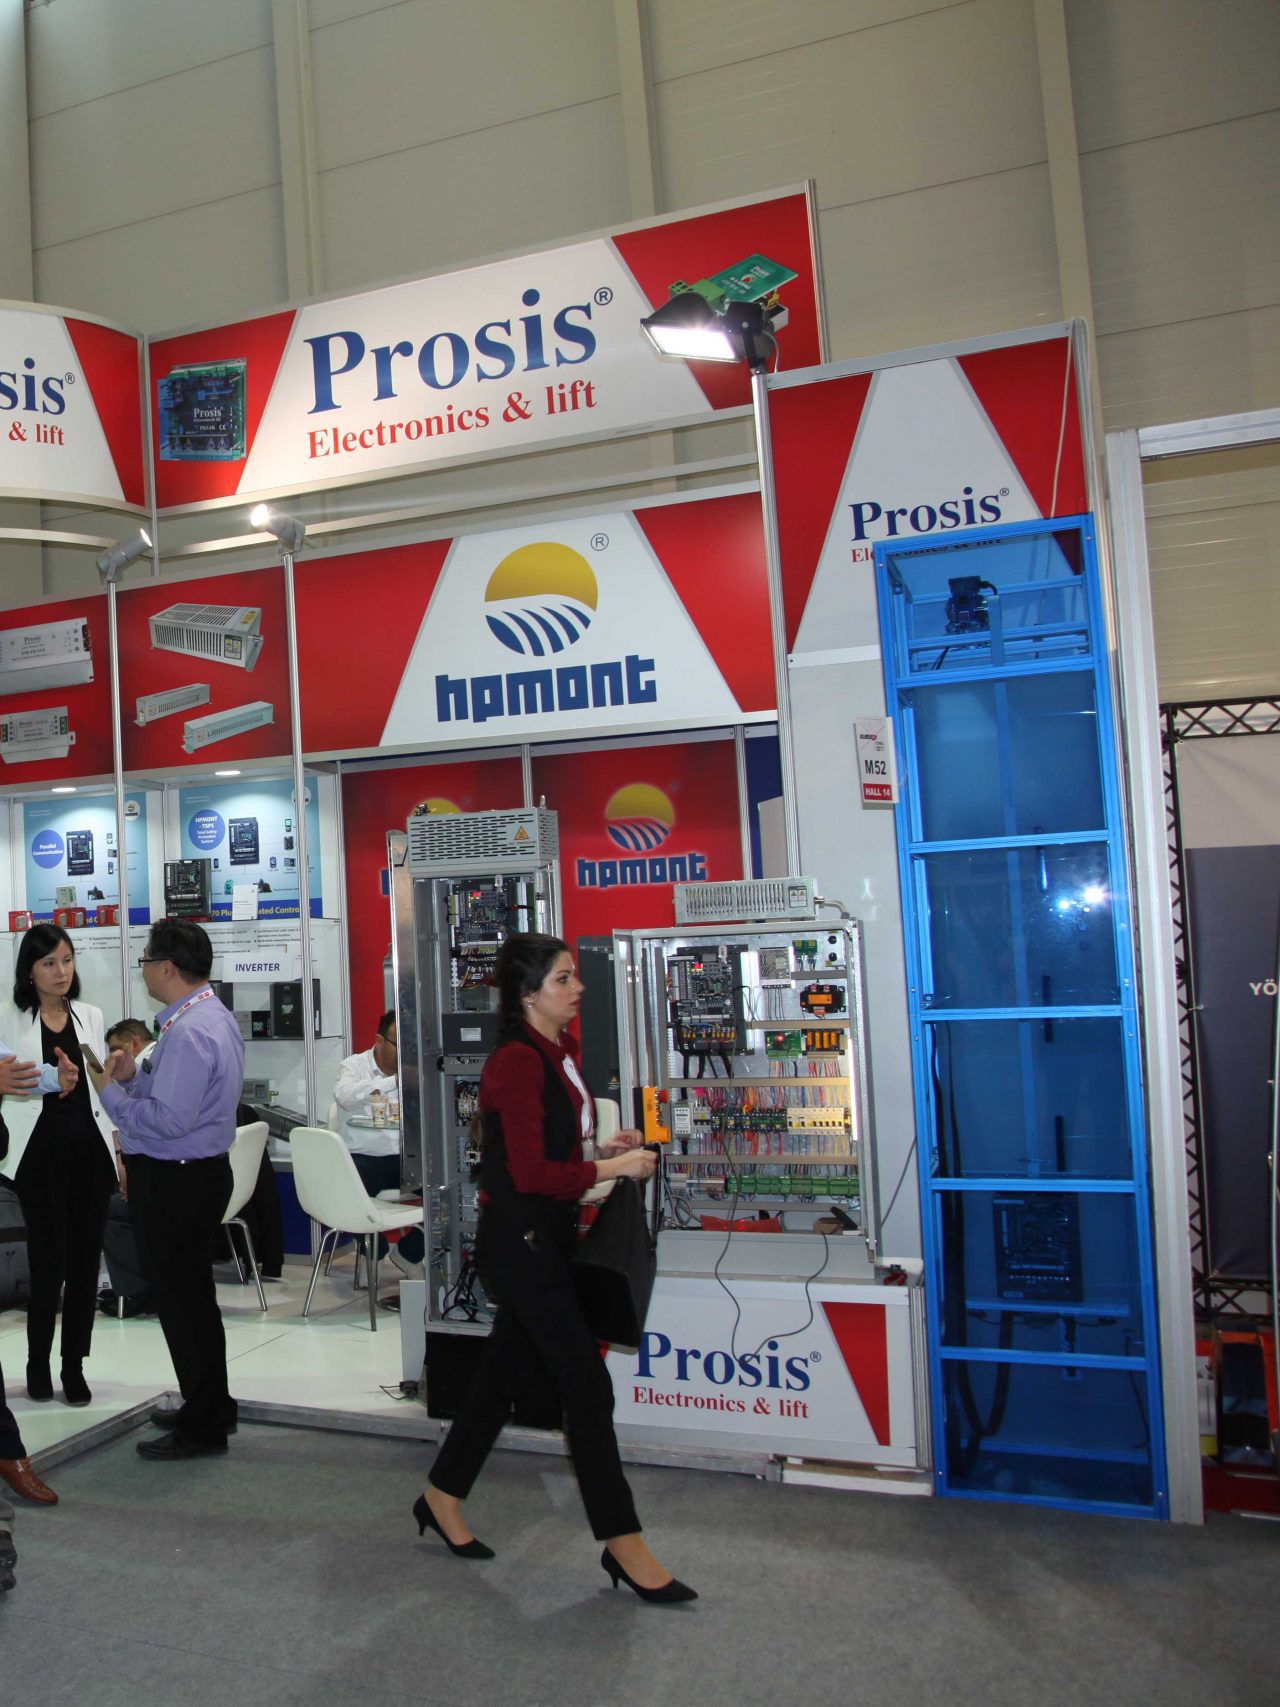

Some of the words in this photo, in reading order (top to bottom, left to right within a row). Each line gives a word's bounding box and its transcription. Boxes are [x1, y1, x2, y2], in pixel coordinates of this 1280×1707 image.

[303, 288, 597, 414] Prosis
[193, 406, 222, 418] Prosis
[308, 405, 490, 459] Electronics
[502, 391, 533, 423] &
[545, 379, 598, 415] lift
[8, 420, 27, 442] &
[35, 423, 65, 446] lift
[848, 486, 1002, 542] Prosis
[435, 654, 658, 723] hpmont
[864, 760, 887, 775] M52
[865, 787, 882, 796] HALL
[882, 788, 891, 797] 14
[577, 852, 707, 888] hpmont
[235, 963, 280, 972] INVERTER
[633, 1331, 810, 1391] Prosis
[633, 1386, 746, 1413] Electronics
[753, 1396, 771, 1415] &
[779, 1398, 809, 1418] lift
